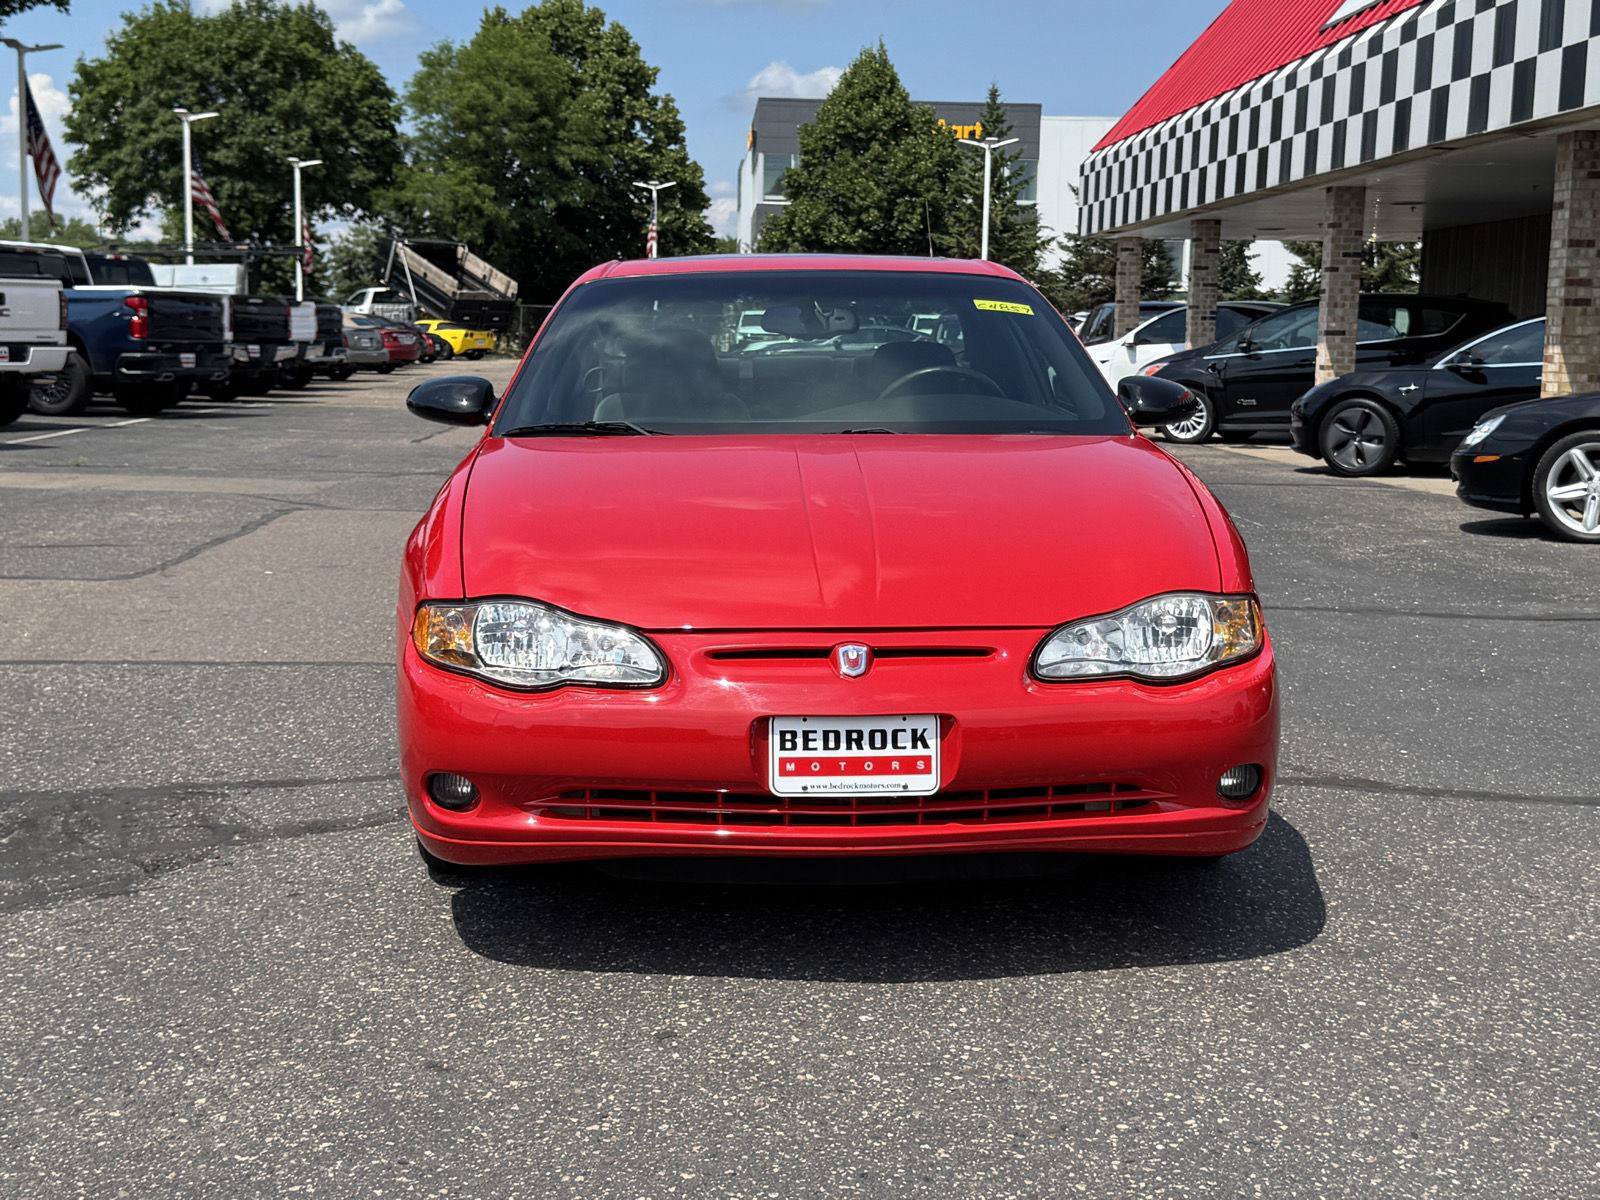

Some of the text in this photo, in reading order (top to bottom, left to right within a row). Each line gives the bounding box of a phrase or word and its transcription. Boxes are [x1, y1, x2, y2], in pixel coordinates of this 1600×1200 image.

[779, 728, 930, 751] BEDROCK
[785, 760, 925, 772] MOTORS
[810, 782, 901, 790] www.bedrockmotors.com
